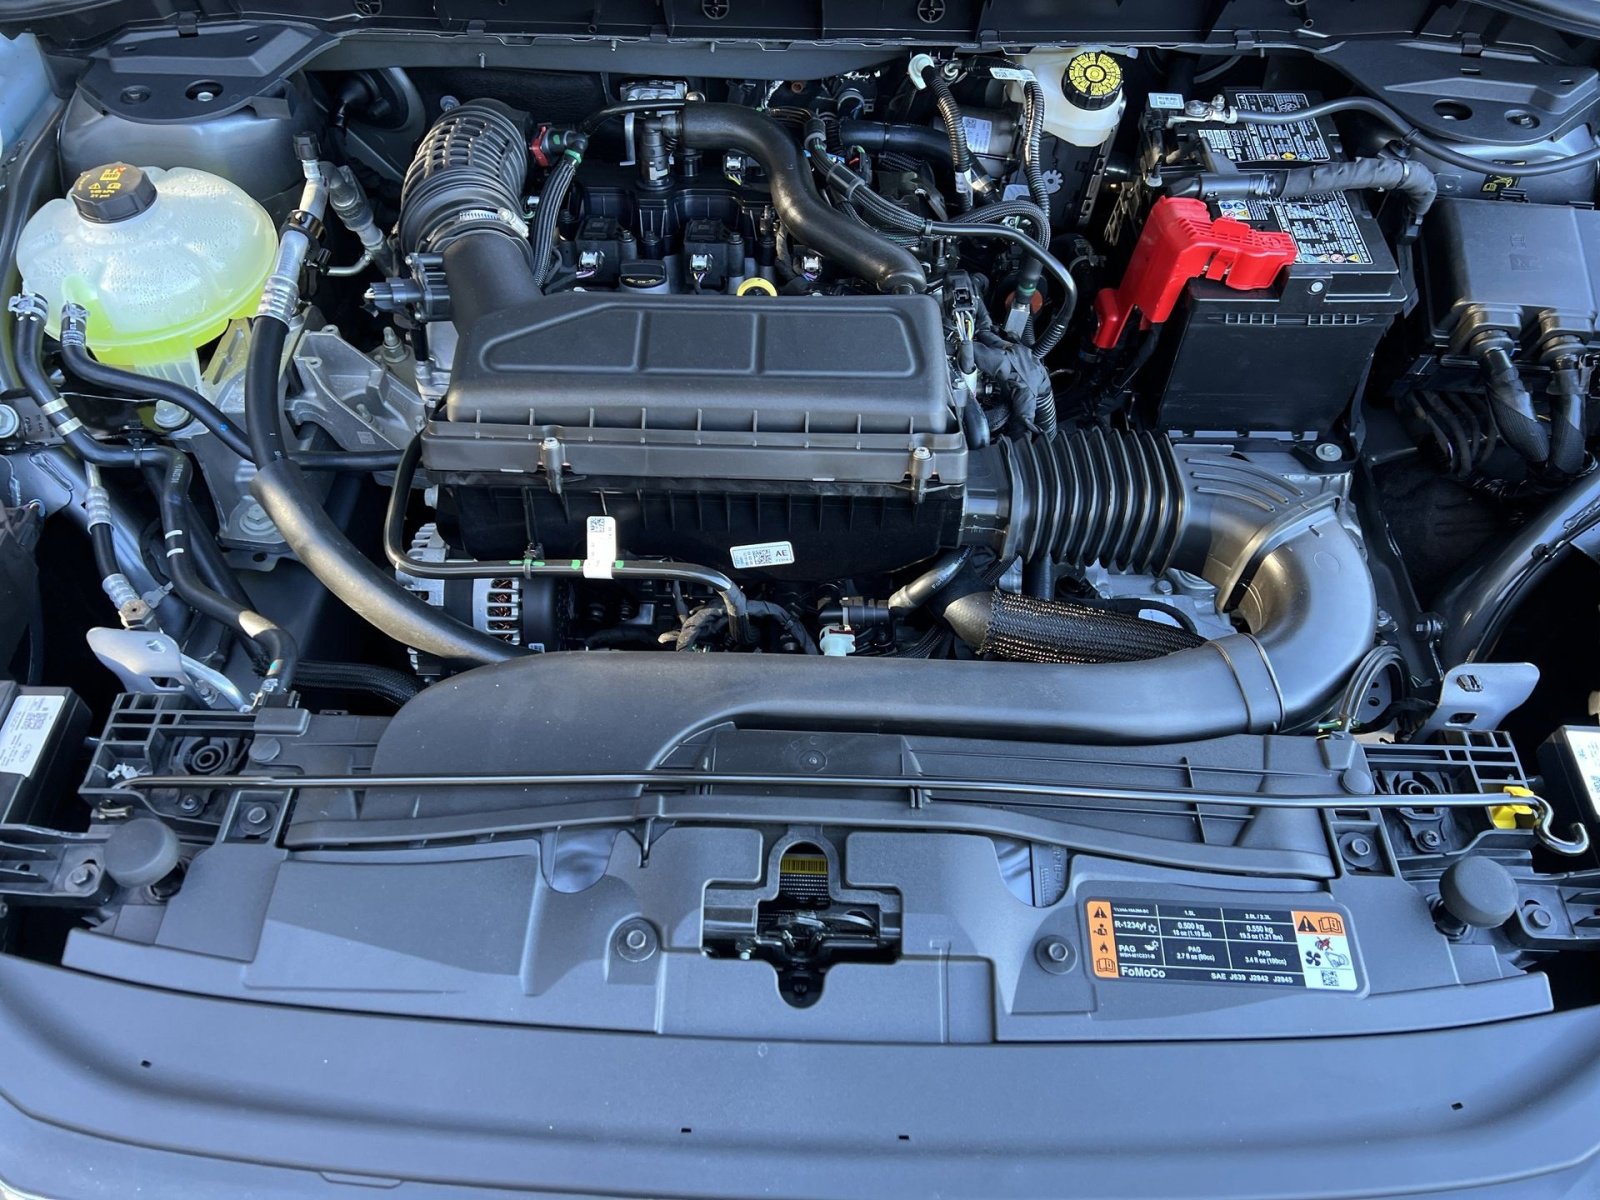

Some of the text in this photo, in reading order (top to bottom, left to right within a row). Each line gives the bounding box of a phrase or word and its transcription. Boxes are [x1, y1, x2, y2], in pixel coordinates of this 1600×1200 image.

[776, 549, 788, 557] AE
[1114, 920, 1147, 930] R-1234yf
[1178, 922, 1204, 932] 0.500 kg
[1246, 925, 1274, 934] 0.550 kg
[1118, 944, 1136, 952] PAG
[1121, 966, 1166, 978] FoMoCo
